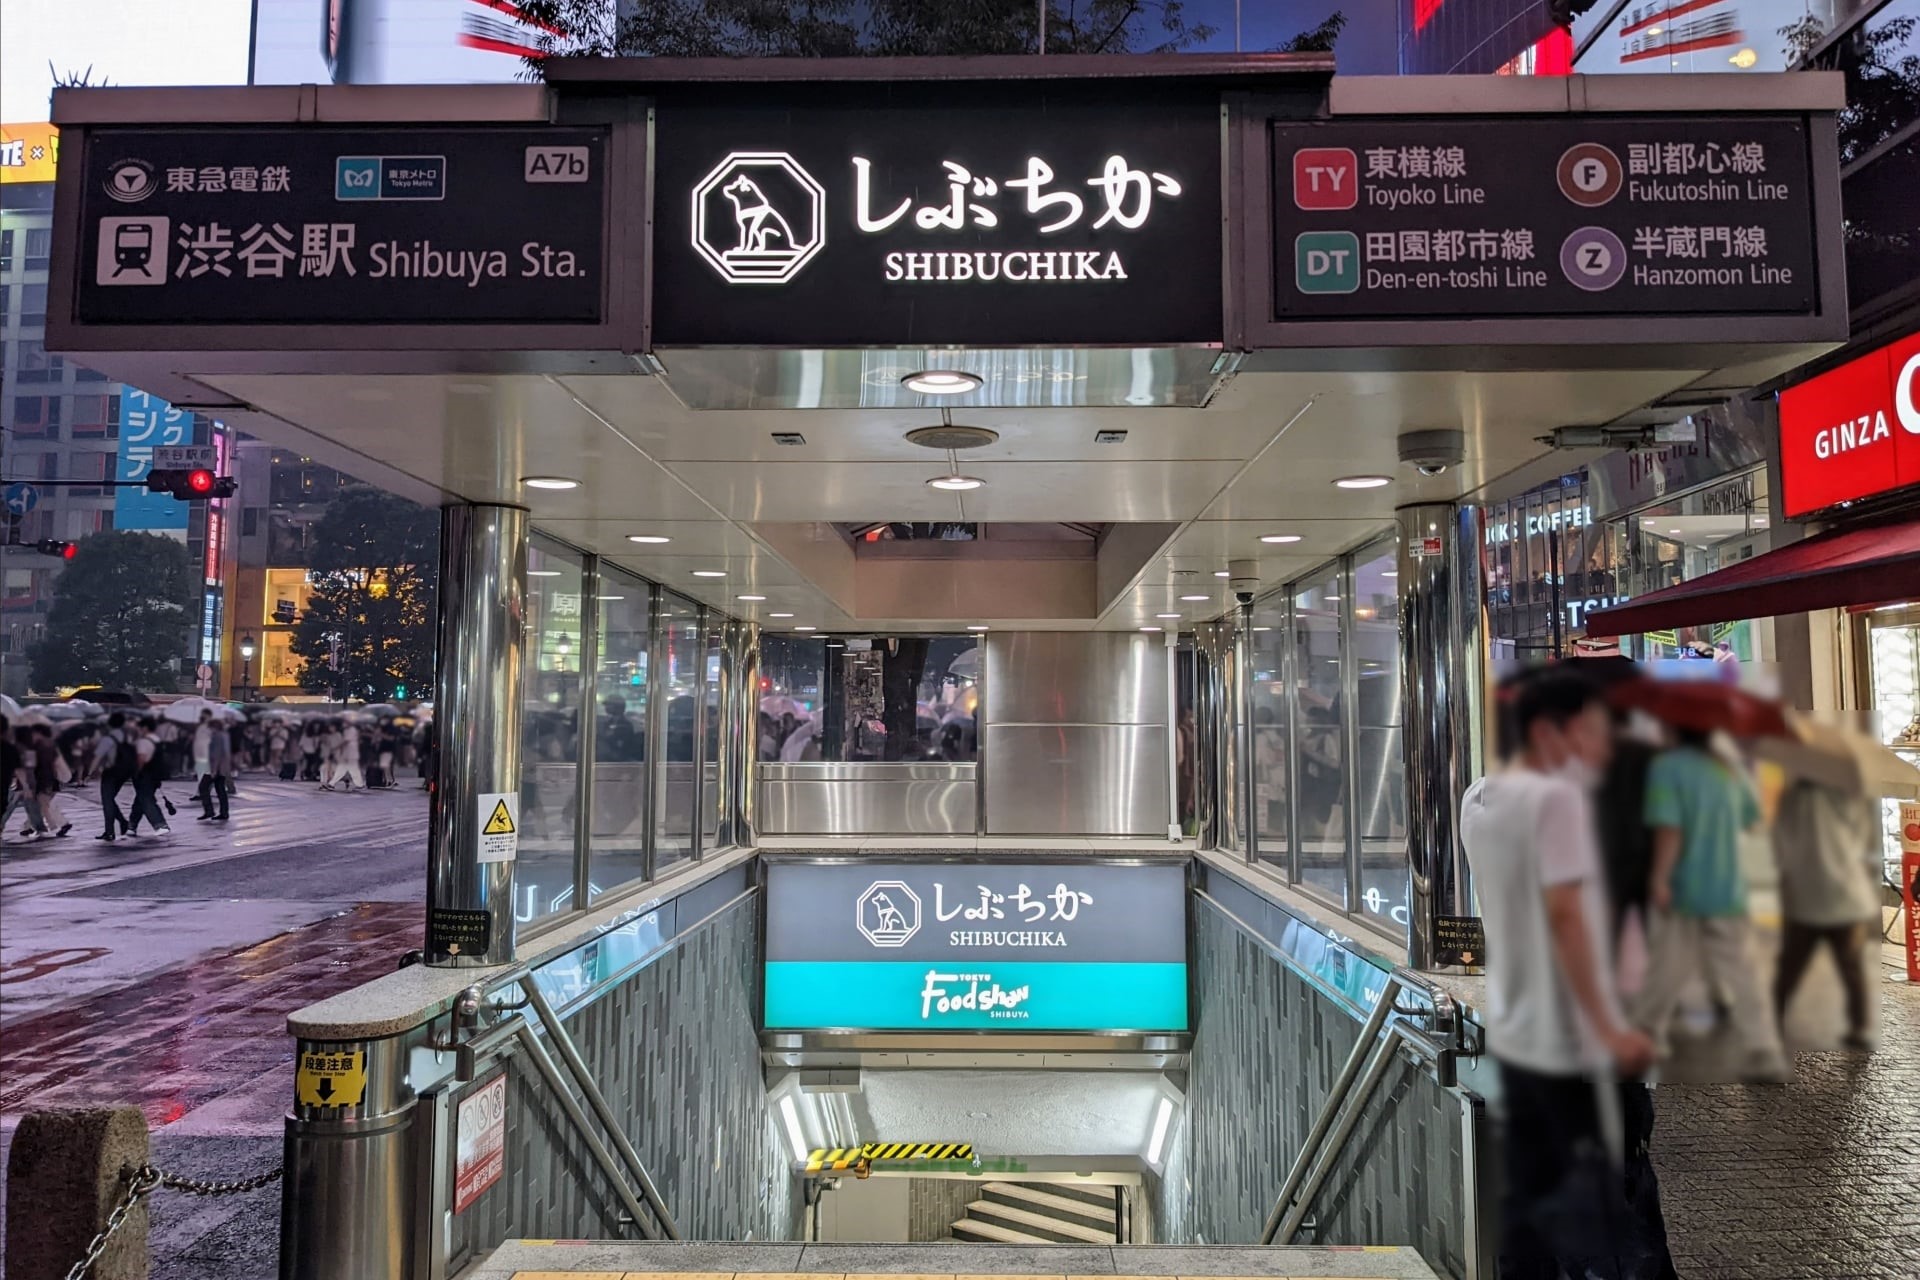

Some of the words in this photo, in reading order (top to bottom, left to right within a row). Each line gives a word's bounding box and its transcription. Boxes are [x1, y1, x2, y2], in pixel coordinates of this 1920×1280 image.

[529, 153, 585, 175] A7b
[1364, 146, 1467, 179] 東横線
[1627, 142, 1767, 175] 副都心線
[166, 165, 291, 192] 東急電鉄
[388, 169, 437, 180] 東京メトロ
[1304, 166, 1347, 192] TY
[1583, 165, 1597, 185] F
[852, 154, 1182, 233] しぶちか
[1365, 183, 1436, 210] Toyoko
[1443, 183, 1485, 204] Line
[1629, 179, 1740, 201] Fukutoshin
[1747, 178, 1789, 200] Line
[175, 222, 357, 279] 渋谷駅
[1366, 228, 1536, 262] 田園都市線
[1632, 225, 1768, 259] 半蔵門線
[368, 240, 507, 287] Shibuya
[521, 242, 586, 277] Sta.
[885, 251, 1128, 280] SHIBUCHIKA
[1306, 250, 1349, 275] DT
[1584, 248, 1603, 269] Z
[1367, 265, 1498, 289] Den-en-toshi
[1506, 265, 1548, 287] Line
[1633, 264, 1743, 286] Hanzomon
[1750, 263, 1792, 285] Line
[1815, 410, 1890, 459] GINZA
[933, 883, 1094, 923] しぶちか
[949, 931, 1067, 947] SHIBUCHIKA
[305, 1056, 354, 1071] 段差注意
